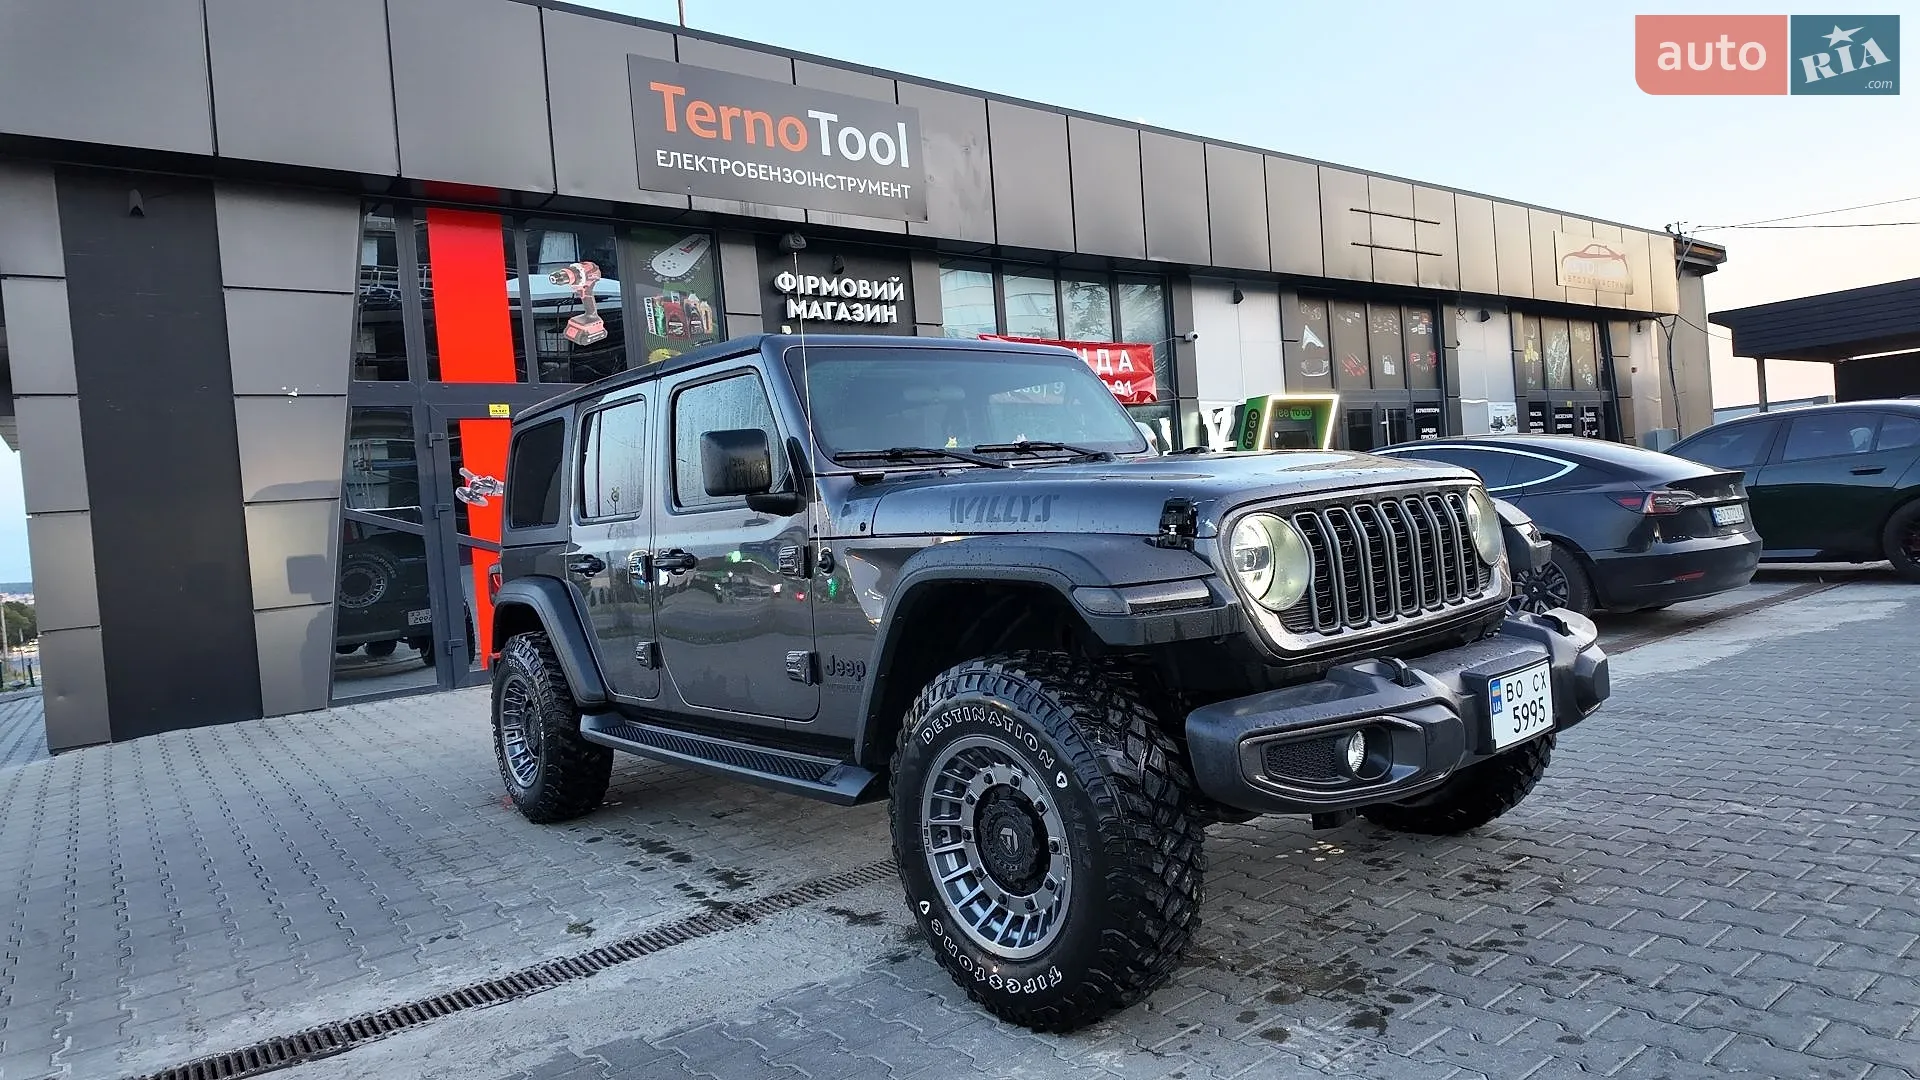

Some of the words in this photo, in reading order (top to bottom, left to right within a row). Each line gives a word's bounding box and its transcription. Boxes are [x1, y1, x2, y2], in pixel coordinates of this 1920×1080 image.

[649, 81, 910, 169] TernoTool
[656, 149, 911, 200] ЕЛЕКТРОБЕНЗОІНСТРУМЕНТ
[774, 270, 905, 302] ФІРМОВИЙ
[786, 298, 898, 325] МАГАЗИН
[950, 494, 1060, 524] WILLYS
[826, 654, 867, 682] Jeep
[1506, 680, 1523, 702] BO
[1533, 670, 1546, 692] CX
[1493, 702, 1502, 712] UA
[1512, 696, 1546, 734] 5995
[920, 706, 1054, 770] DESTINATION
